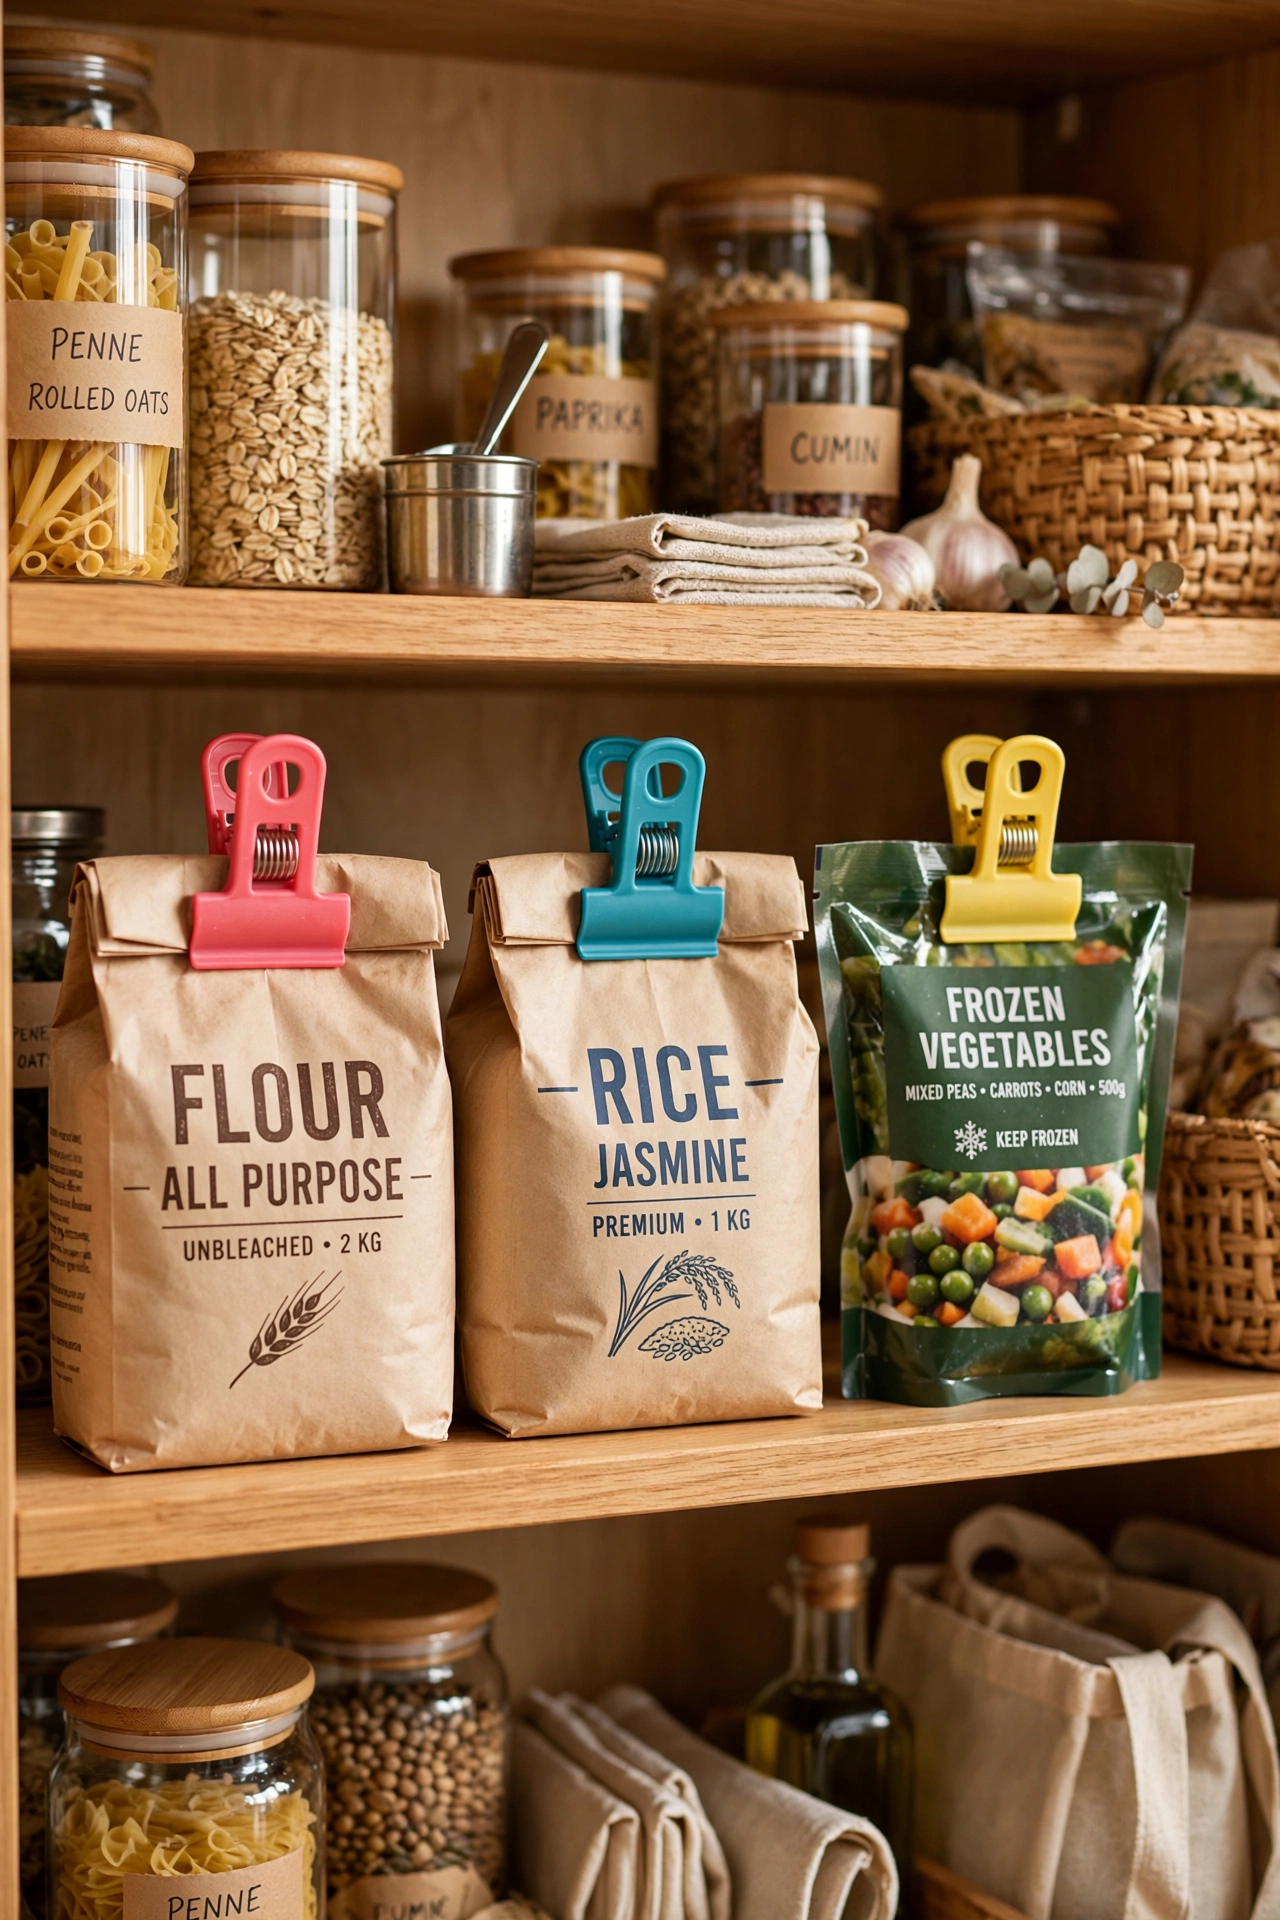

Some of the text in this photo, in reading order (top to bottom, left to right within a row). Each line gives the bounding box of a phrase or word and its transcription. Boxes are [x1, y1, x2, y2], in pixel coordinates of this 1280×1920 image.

[52, 327, 143, 362] PENNE
[29, 382, 169, 415] ROLLED OATS
[536, 395, 644, 434] PAPRIKA
[790, 432, 881, 465] CUMIN
[946, 985, 1066, 1024] FROZEN
[919, 1028, 1112, 1070] VEGETABLES
[171, 1060, 390, 1145] FLOUR
[587, 1044, 739, 1126] RICE
[905, 1078, 1126, 1101] MIXED PEAS CARROTS CORN 500g
[996, 1128, 1079, 1148] KEEP FROZEN
[593, 1137, 750, 1189] JASMINE
[161, 1157, 404, 1211] ALL PURPOSE
[593, 1208, 751, 1238] PREMIUM 1 KG
[183, 1231, 382, 1262] UNBLEACHED 2 KG
[168, 1884, 261, 1920] PENNE
